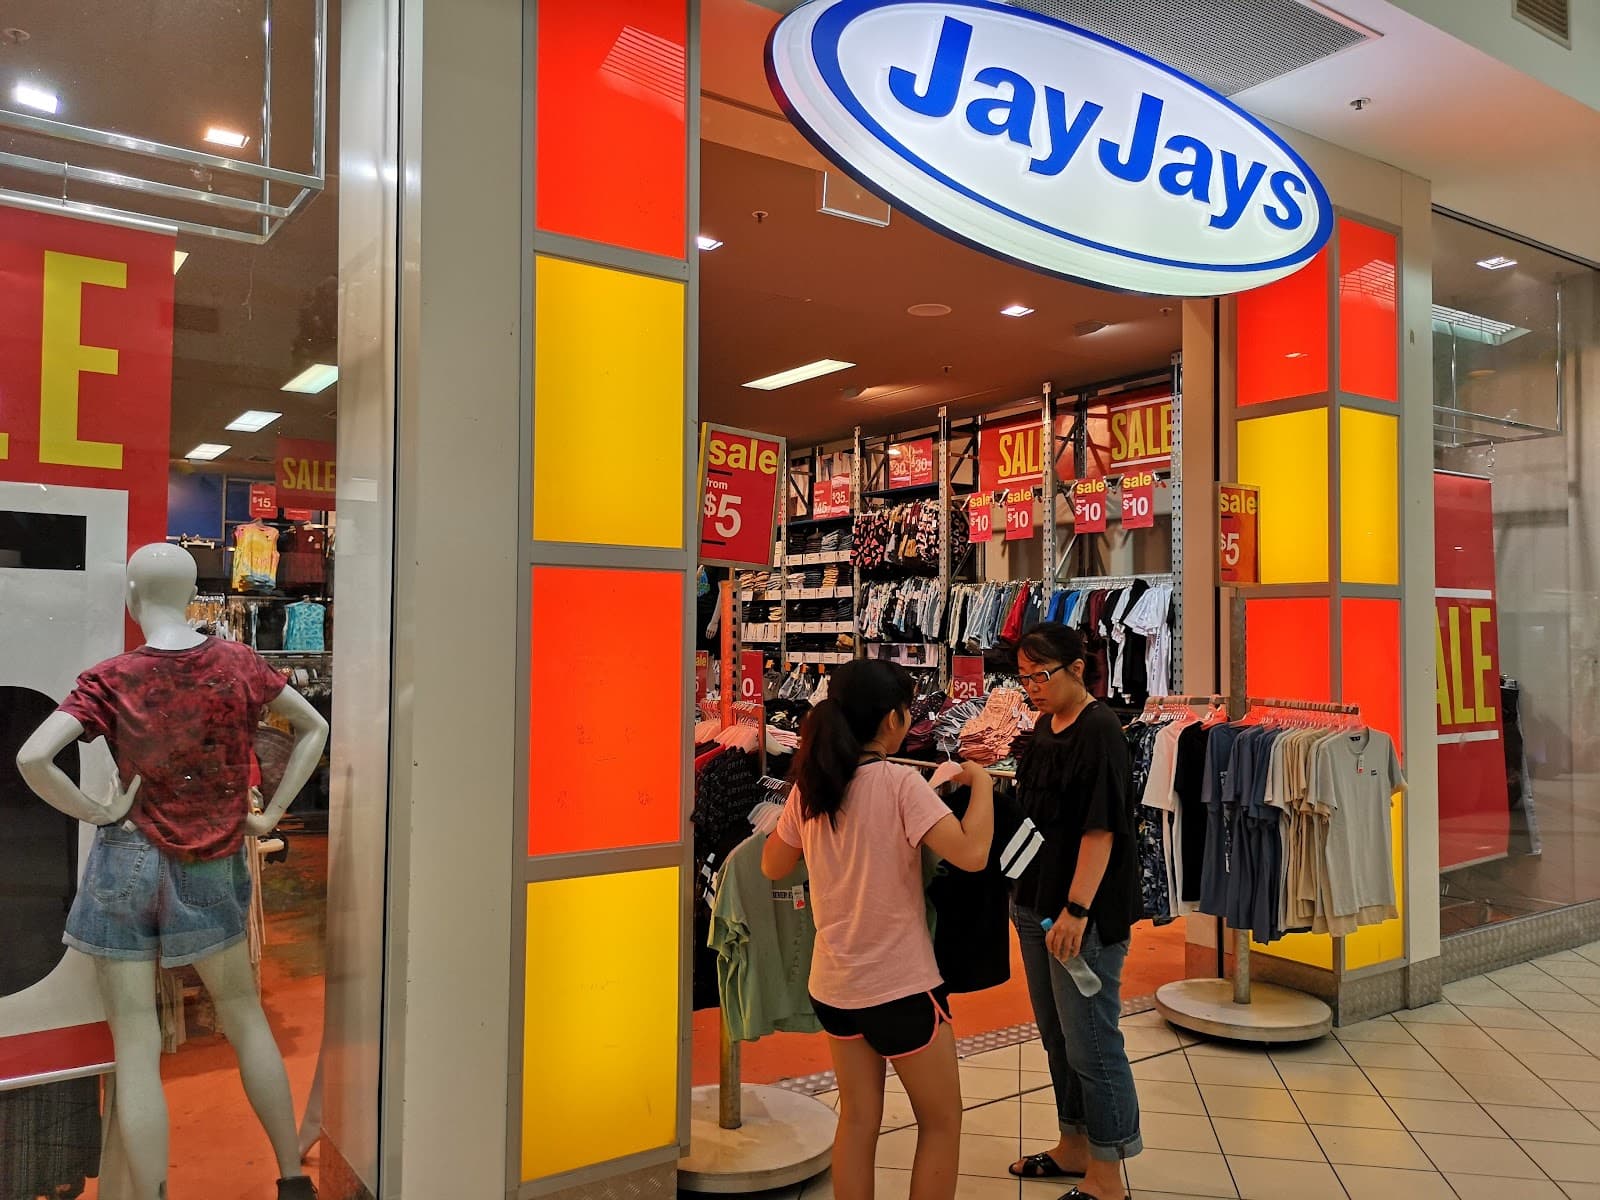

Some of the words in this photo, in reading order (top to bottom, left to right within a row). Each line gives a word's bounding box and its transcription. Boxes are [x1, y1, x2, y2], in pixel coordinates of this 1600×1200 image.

[1111, 404, 1173, 460] SALE
[708, 438, 778, 474] sale
[283, 457, 336, 492] SALE
[1123, 472, 1152, 489] sale
[1007, 489, 1031, 504] sale
[1076, 479, 1105, 494] sale
[1075, 502, 1101, 521] $10
[1122, 496, 1149, 517] $10
[1220, 490, 1257, 515] sale
[704, 491, 742, 538] $5
[970, 514, 989, 532] $10
[1007, 510, 1029, 529] $10
[1220, 532, 1240, 566] $5
[954, 680, 978, 699] $25
